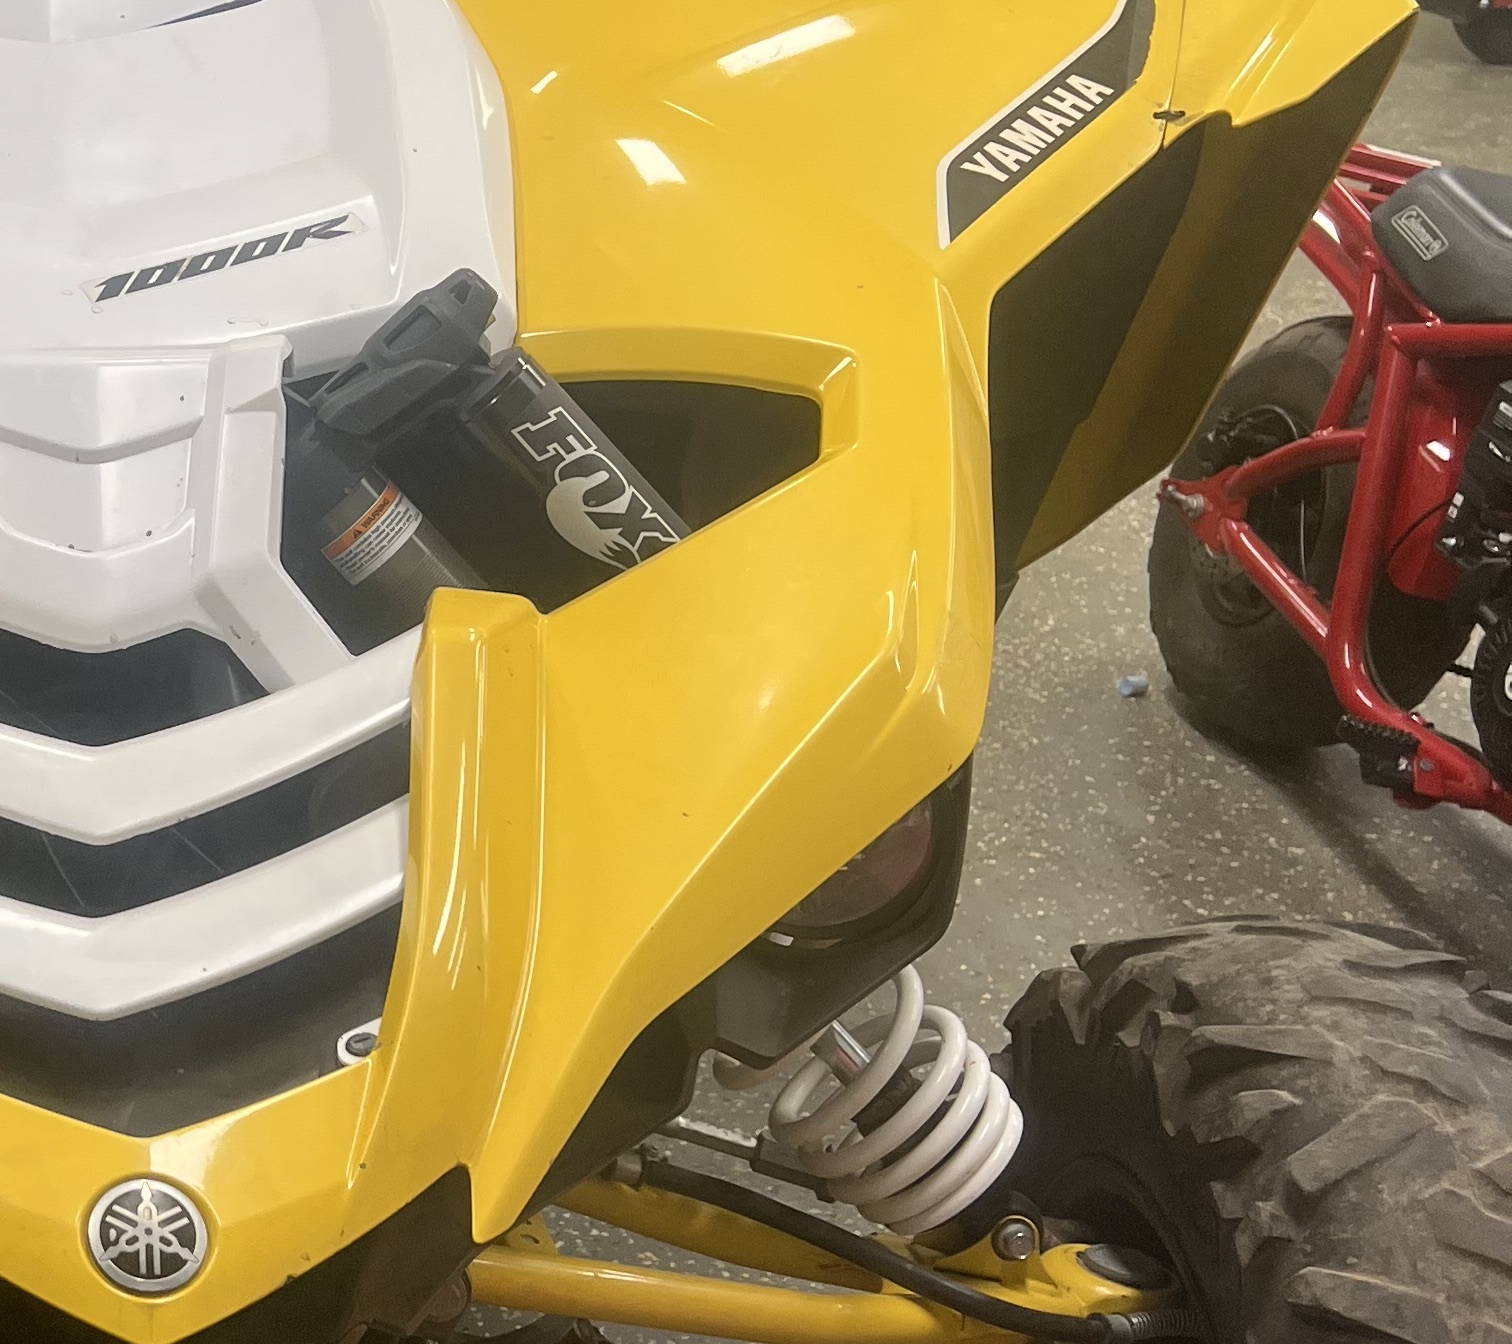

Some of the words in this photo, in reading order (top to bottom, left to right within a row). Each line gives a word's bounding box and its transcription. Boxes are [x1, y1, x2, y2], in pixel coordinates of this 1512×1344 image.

[960, 74, 1115, 182] YAMAHA
[94, 213, 353, 303] 1000R
[510, 406, 681, 554] FOX
